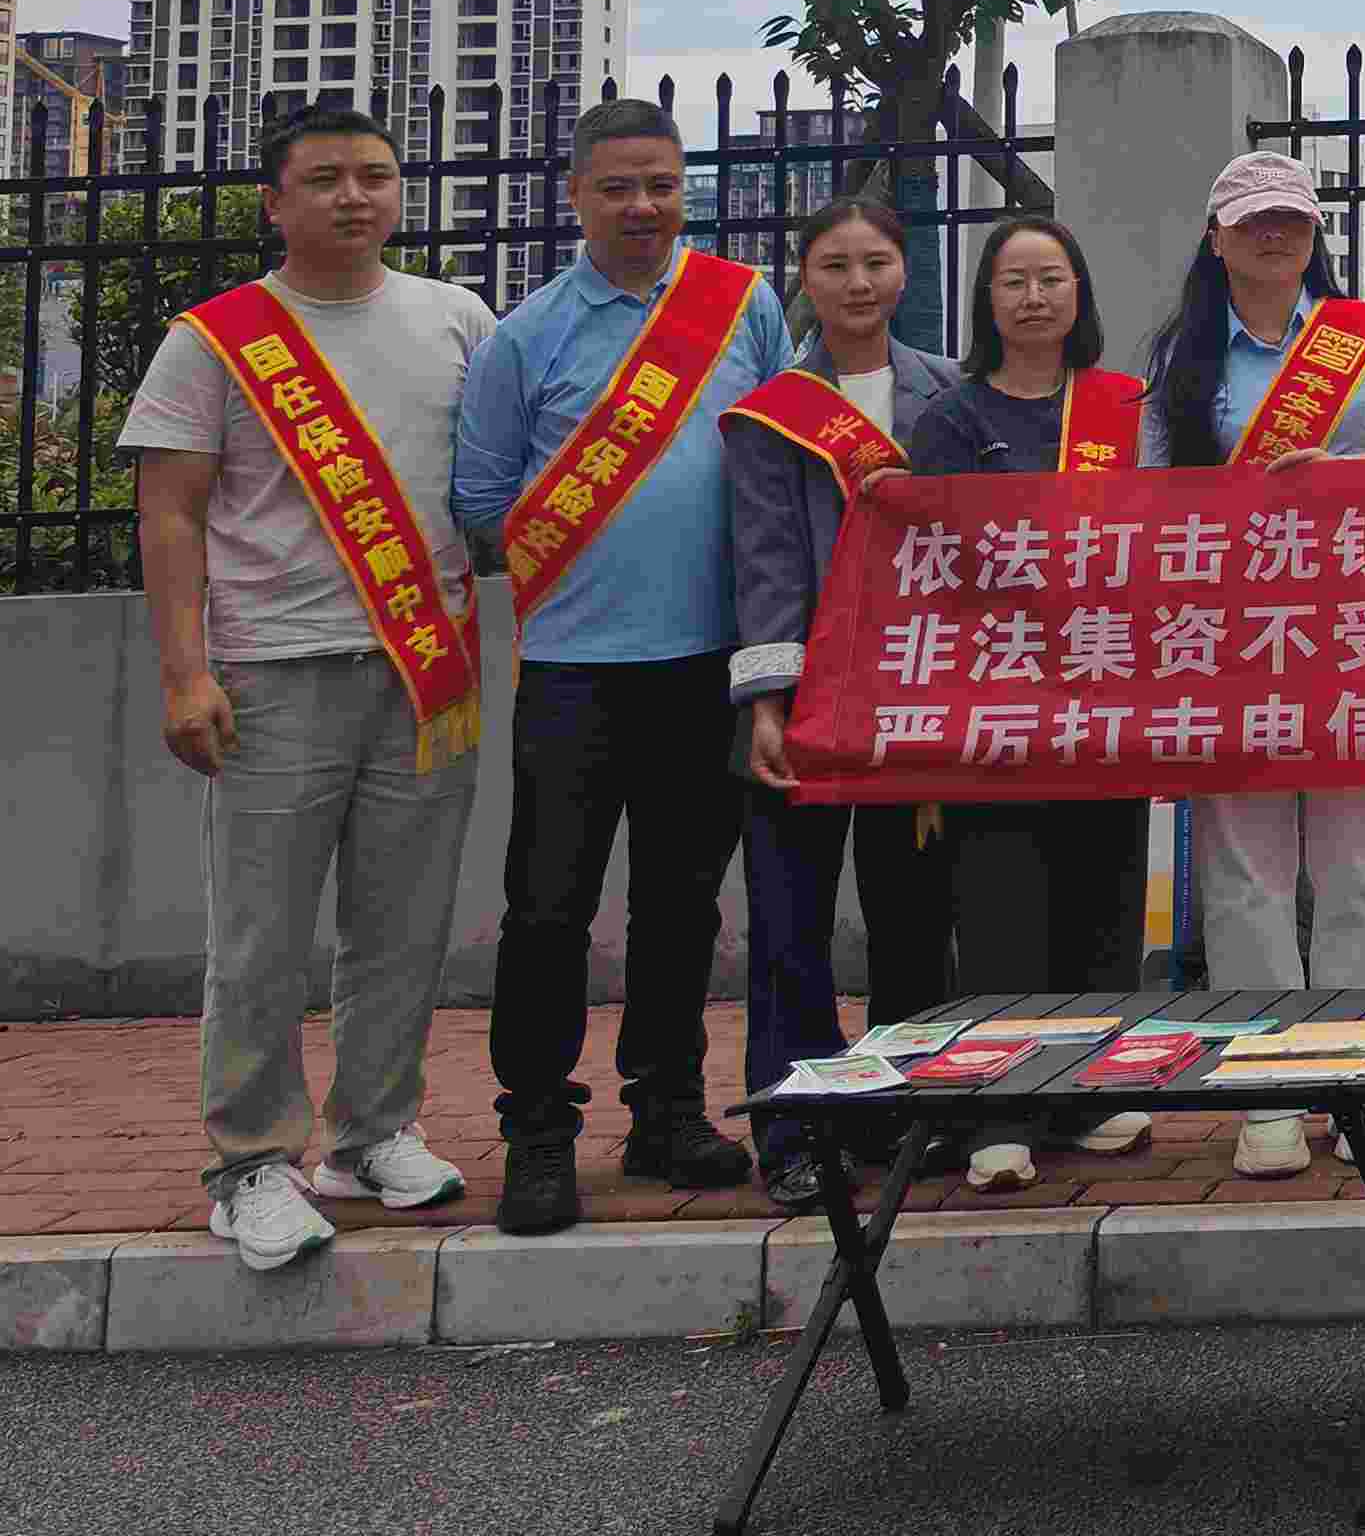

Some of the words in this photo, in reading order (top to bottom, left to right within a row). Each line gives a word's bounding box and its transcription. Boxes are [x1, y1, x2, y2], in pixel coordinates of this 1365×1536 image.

[240, 333, 450, 671] 国任保险安顺中支
